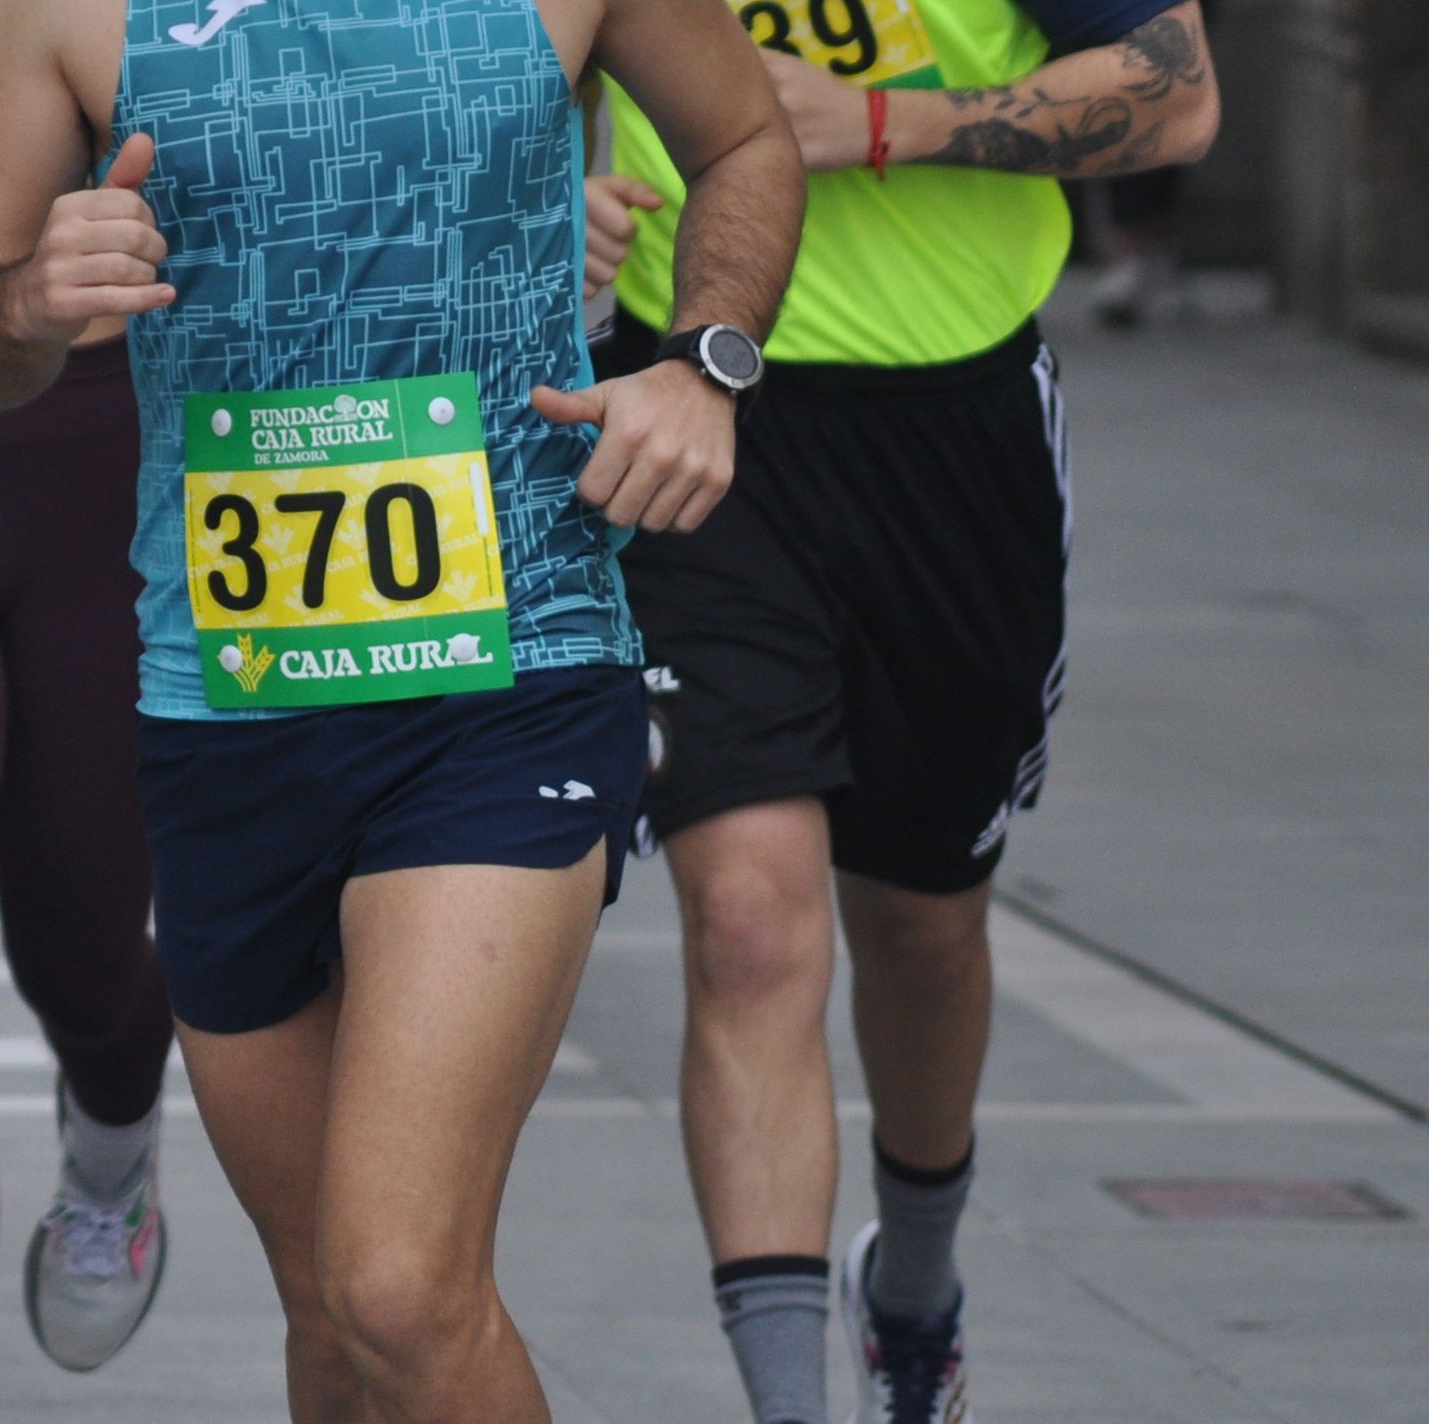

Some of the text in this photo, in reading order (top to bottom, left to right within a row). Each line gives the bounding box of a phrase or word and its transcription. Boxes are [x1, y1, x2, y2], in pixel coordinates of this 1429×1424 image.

[251, 420, 395, 451] CAJA RURAL
[254, 449, 330, 465] DE ZAMORA
[204, 482, 442, 612] 370
[279, 647, 363, 680] CAJA
